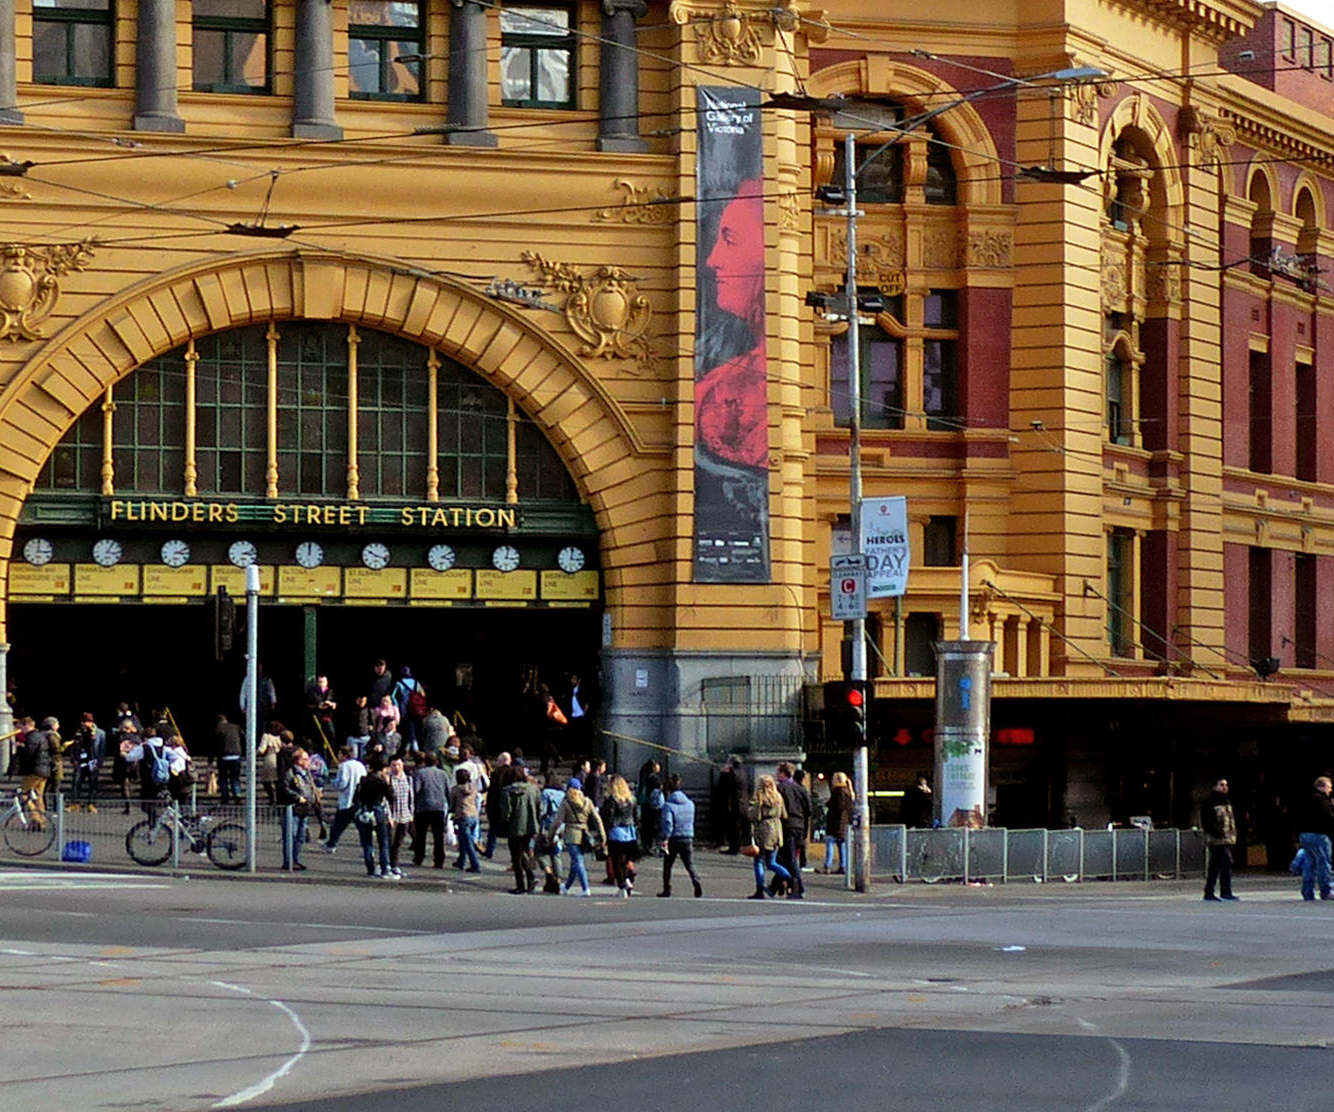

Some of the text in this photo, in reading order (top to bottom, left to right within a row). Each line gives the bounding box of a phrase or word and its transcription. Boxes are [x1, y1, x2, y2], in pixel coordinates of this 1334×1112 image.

[879, 273, 901, 283] CUT
[881, 284, 902, 294] OFF
[111, 500, 516, 529] FLINDERS STREET STATION
[866, 534, 905, 545] HEROES
[865, 553, 907, 571] DAY
